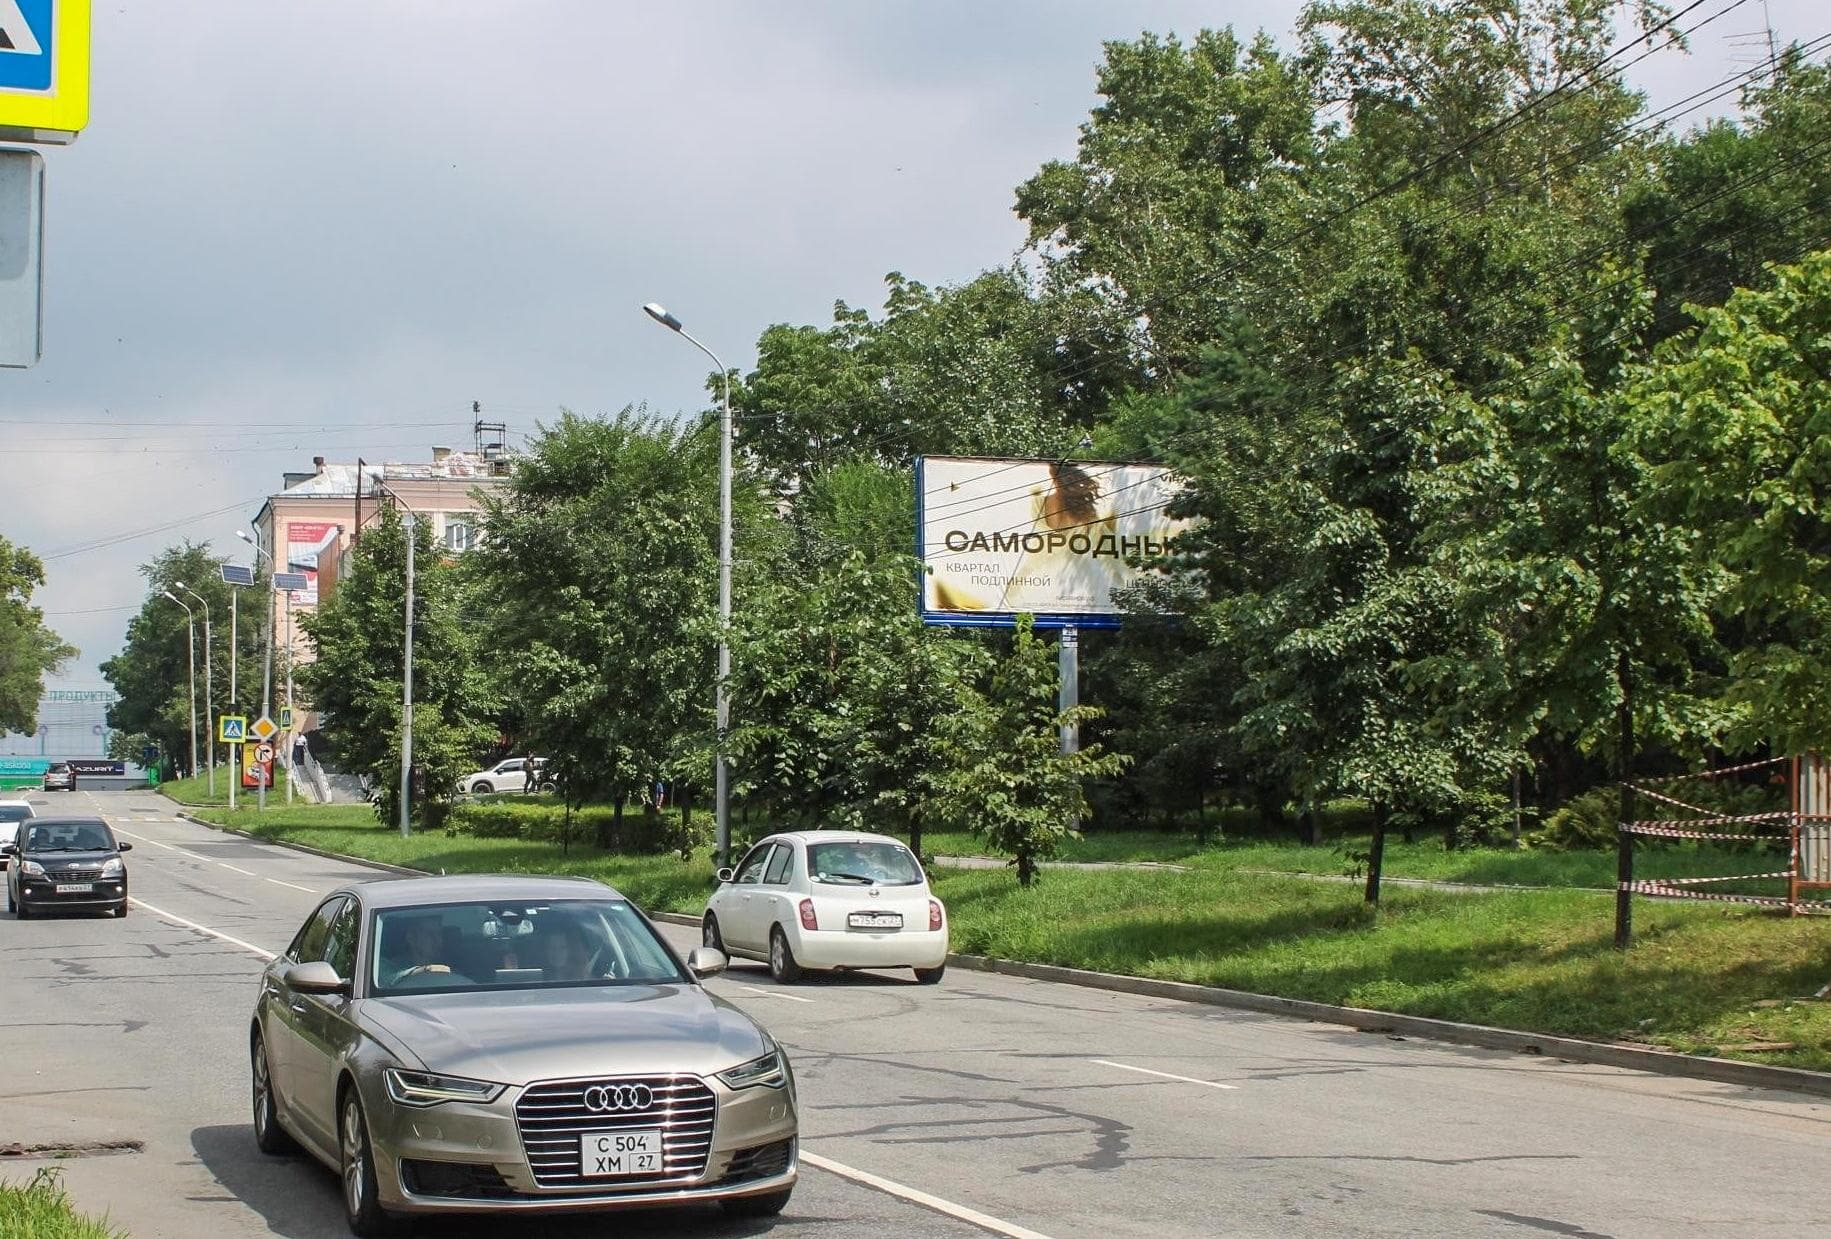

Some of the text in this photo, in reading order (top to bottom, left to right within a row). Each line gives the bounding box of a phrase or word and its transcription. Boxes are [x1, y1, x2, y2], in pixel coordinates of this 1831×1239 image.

[946, 530, 1176, 559] САМОРОДНЫ
[946, 562, 1000, 573] КВАРТАЛ
[971, 574, 1051, 588] ПОДЛИННОЙ
[49, 690, 116, 702] ПРОДУКТЫ
[598, 1136, 647, 1152] С 504
[596, 1155, 653, 1172] ХМ 27
